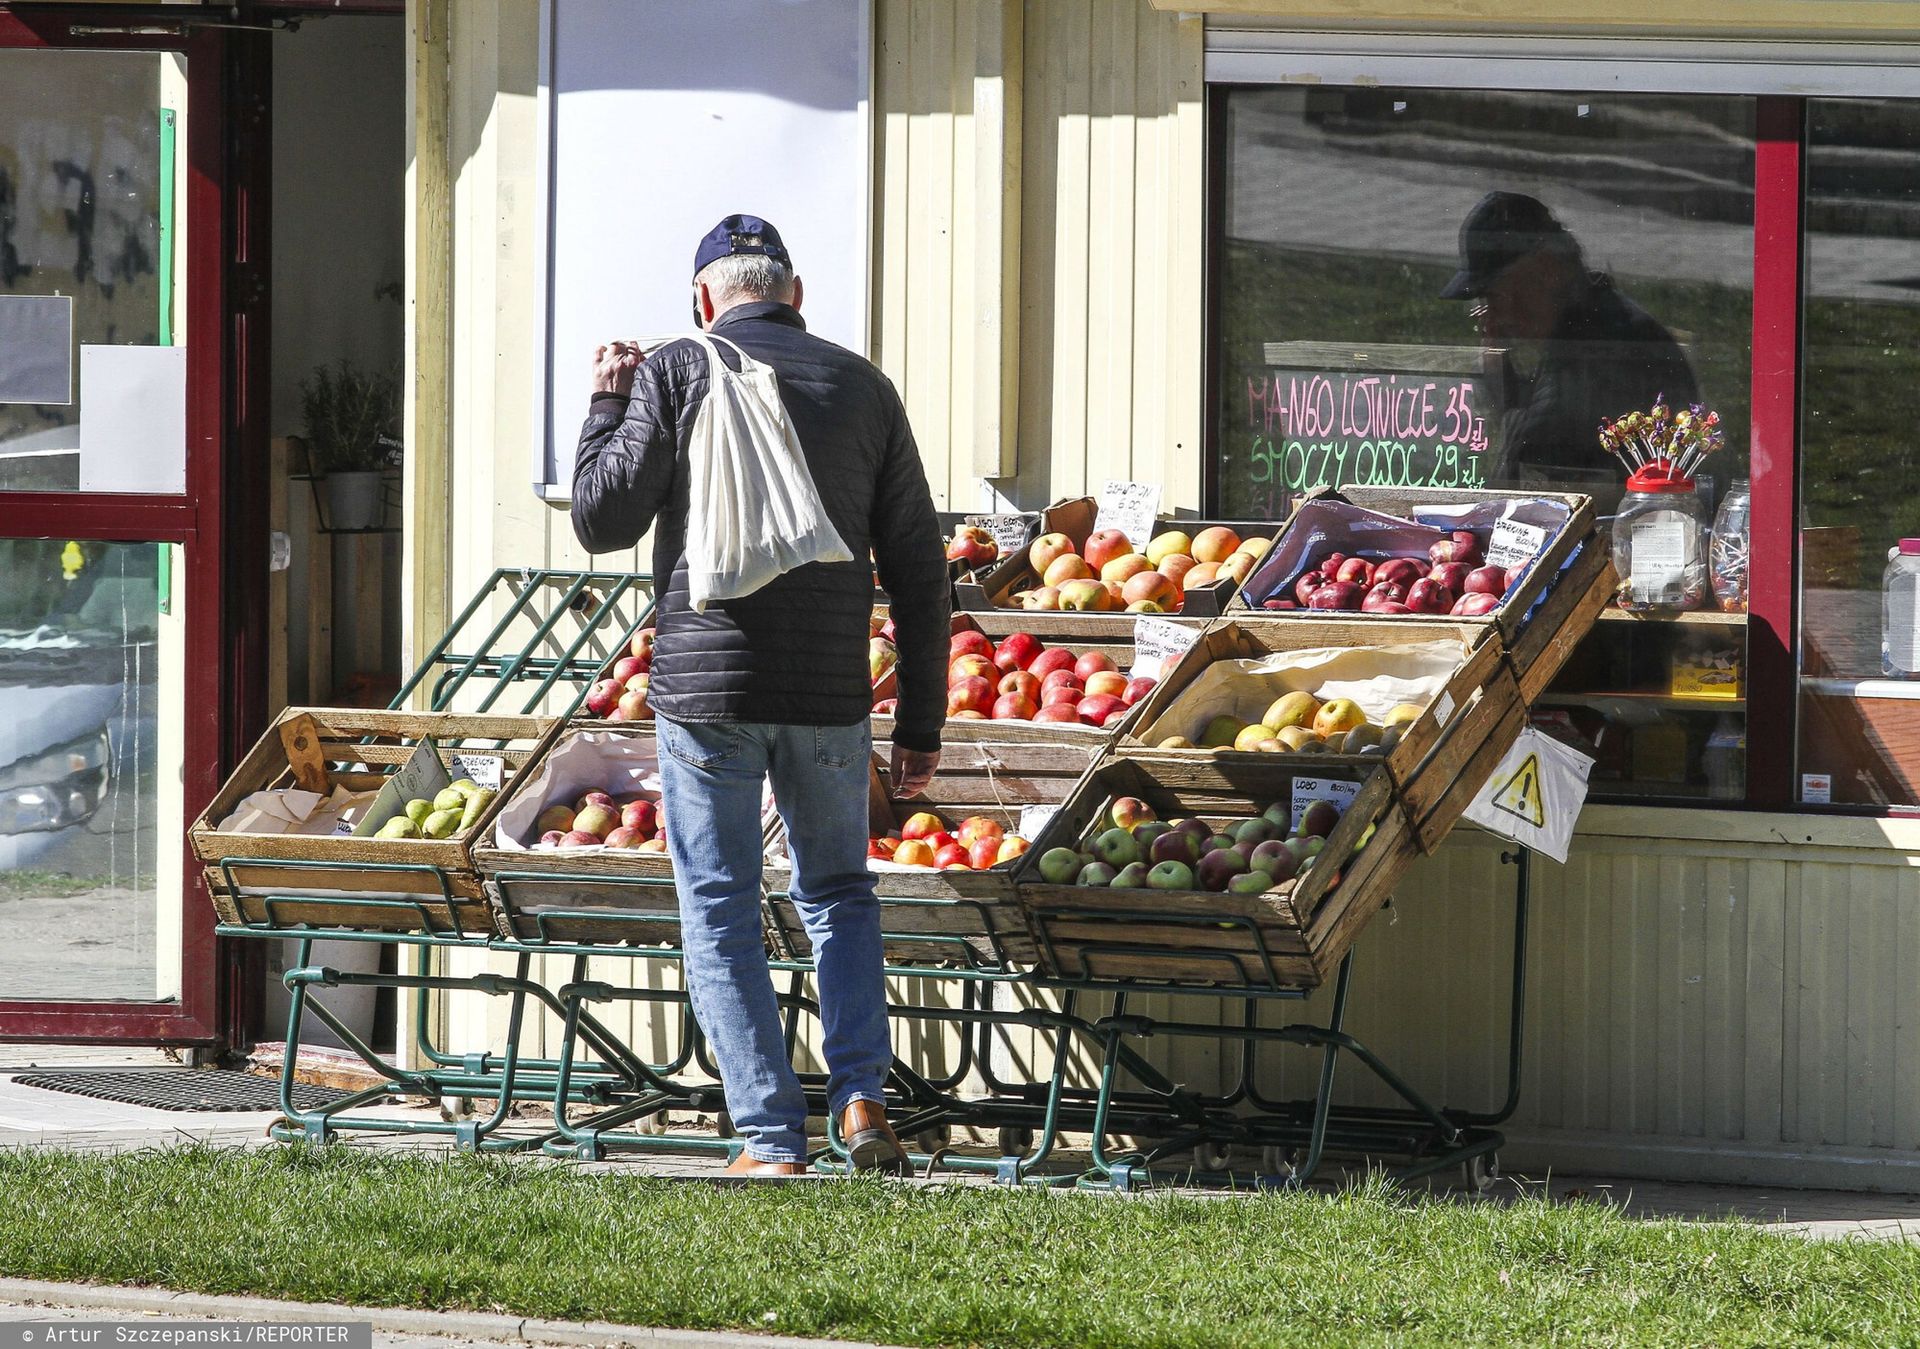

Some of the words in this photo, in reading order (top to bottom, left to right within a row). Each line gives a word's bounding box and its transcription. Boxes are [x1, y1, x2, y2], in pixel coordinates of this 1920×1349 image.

[1247, 374, 1335, 437] MANGO
[1341, 374, 1438, 438] LOTNICZE
[1441, 383, 1473, 444] 35
[1250, 438, 1349, 493] SMOCZY
[1428, 445, 1459, 488] 29
[1295, 780, 1318, 791] LOBO
